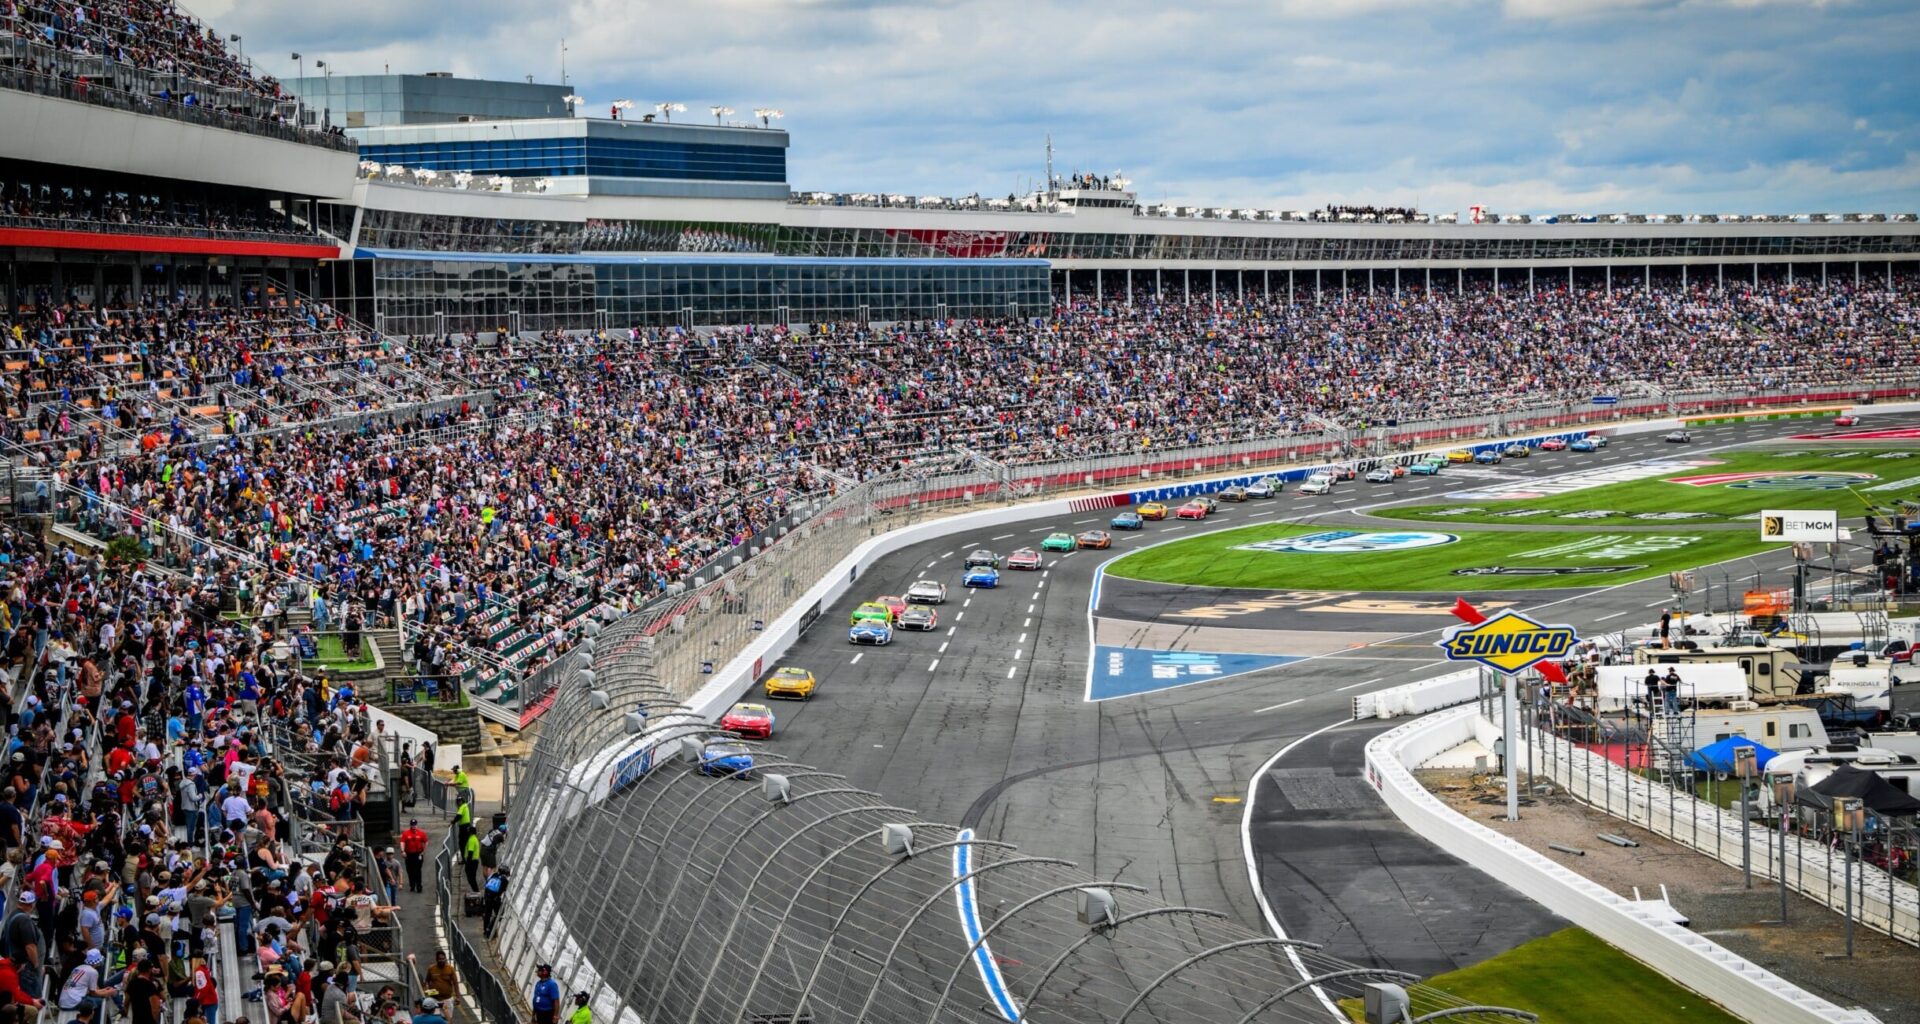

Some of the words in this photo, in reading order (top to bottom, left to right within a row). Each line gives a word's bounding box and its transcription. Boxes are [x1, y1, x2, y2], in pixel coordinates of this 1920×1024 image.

[1357, 453, 1431, 472] CHALOTT
[1785, 521, 1833, 530] BETMGM
[1453, 632, 1569, 655] SUNOCO
